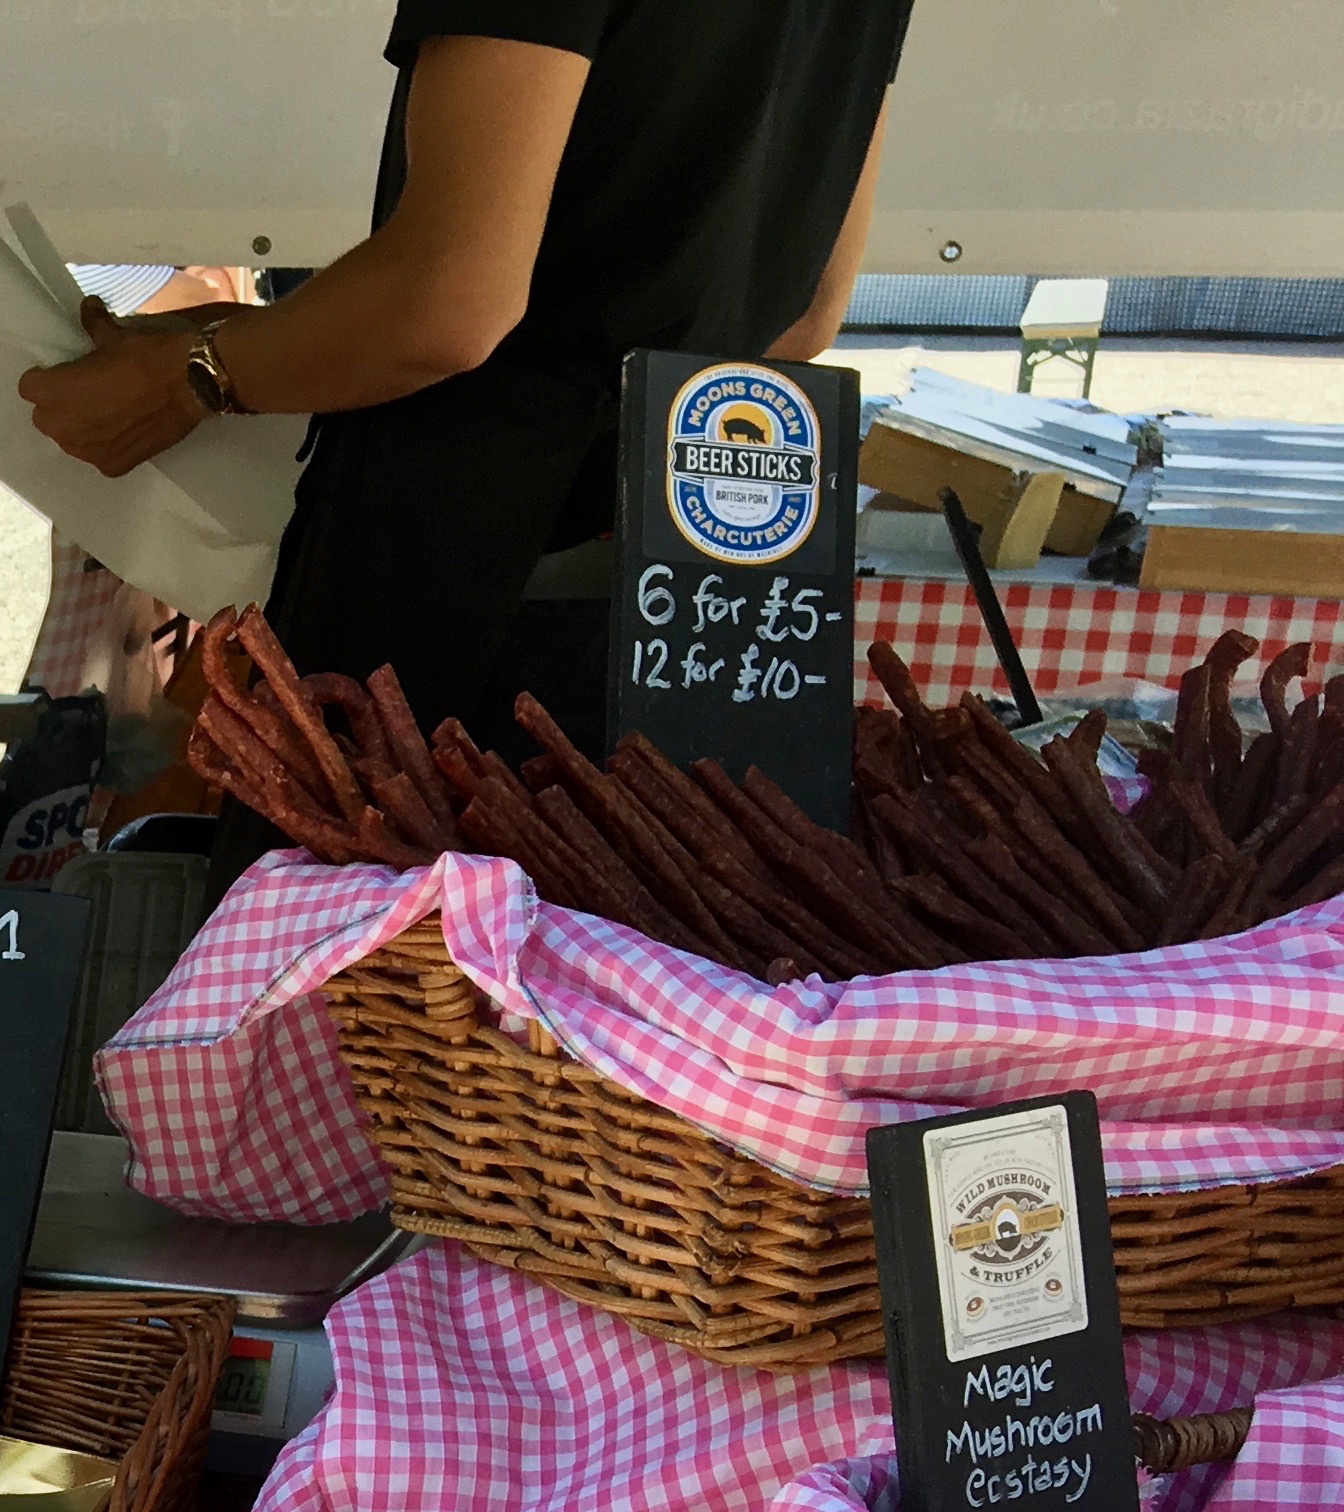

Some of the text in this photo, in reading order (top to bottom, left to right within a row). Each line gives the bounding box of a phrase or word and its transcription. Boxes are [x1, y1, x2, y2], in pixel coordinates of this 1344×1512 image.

[688, 381, 802, 436] MOONS GREEN
[686, 446, 802, 481] BEER STICKS
[686, 495, 800, 546] CHARCUTERIE
[715, 489, 769, 506] BRITISH PORK
[638, 564, 676, 626] 6
[691, 574, 747, 633] for
[632, 638, 672, 690] 12
[680, 642, 726, 690] for
[955, 1182, 986, 1214] WILD
[986, 1172, 1053, 1197] MUSHROOM
[969, 1246, 1054, 1283] & TRUFFLE
[963, 1356, 1055, 1408] Magic
[945, 1403, 1104, 1464] Mushroom
